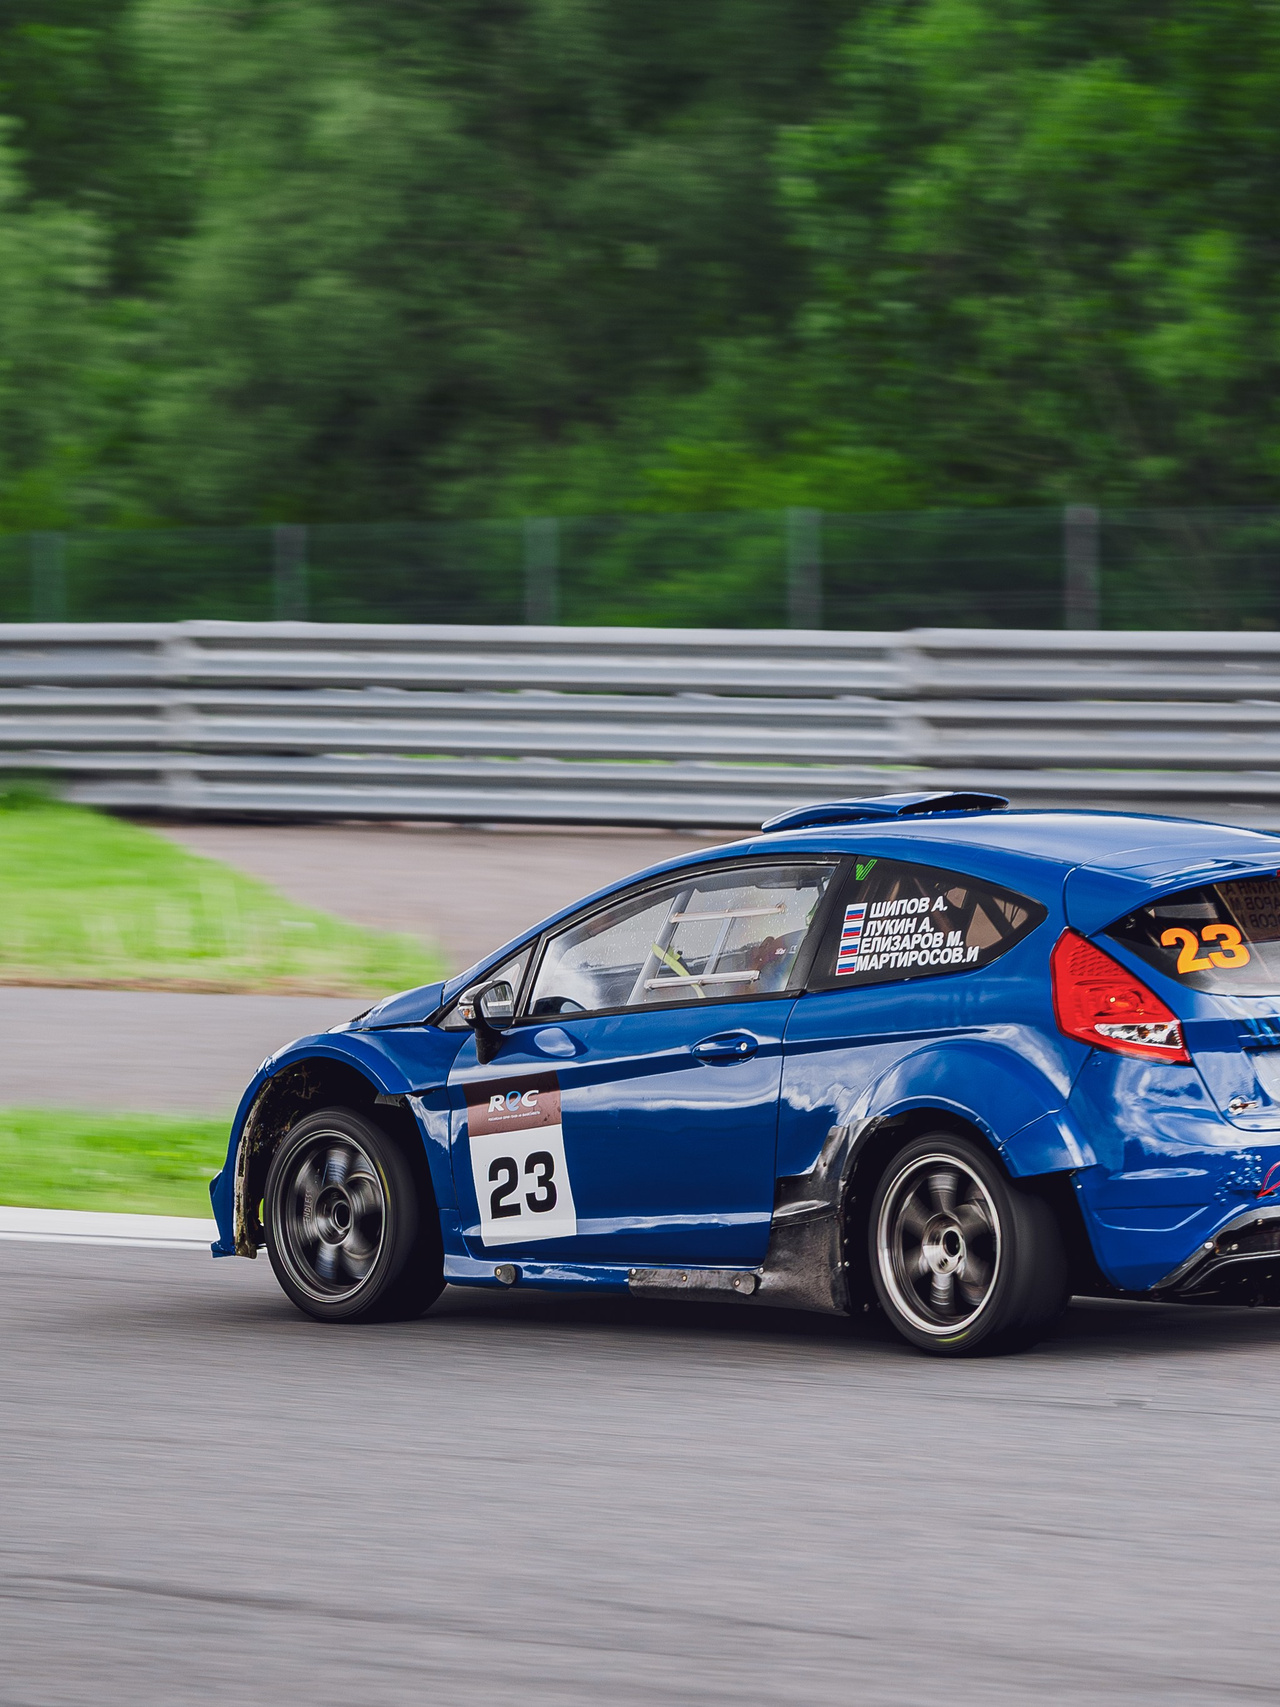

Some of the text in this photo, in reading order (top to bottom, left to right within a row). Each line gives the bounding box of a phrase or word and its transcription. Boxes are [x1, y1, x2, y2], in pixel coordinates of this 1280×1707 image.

[869, 895, 948, 918] ШИПОВ А.
[863, 916, 935, 937] ЛУКИН А.
[859, 930, 964, 954] ЕЛИЗАРОВ М.
[1160, 923, 1251, 974] 23
[855, 946, 980, 972] МАРТИРОСОВ.И
[488, 1150, 558, 1220] 23
